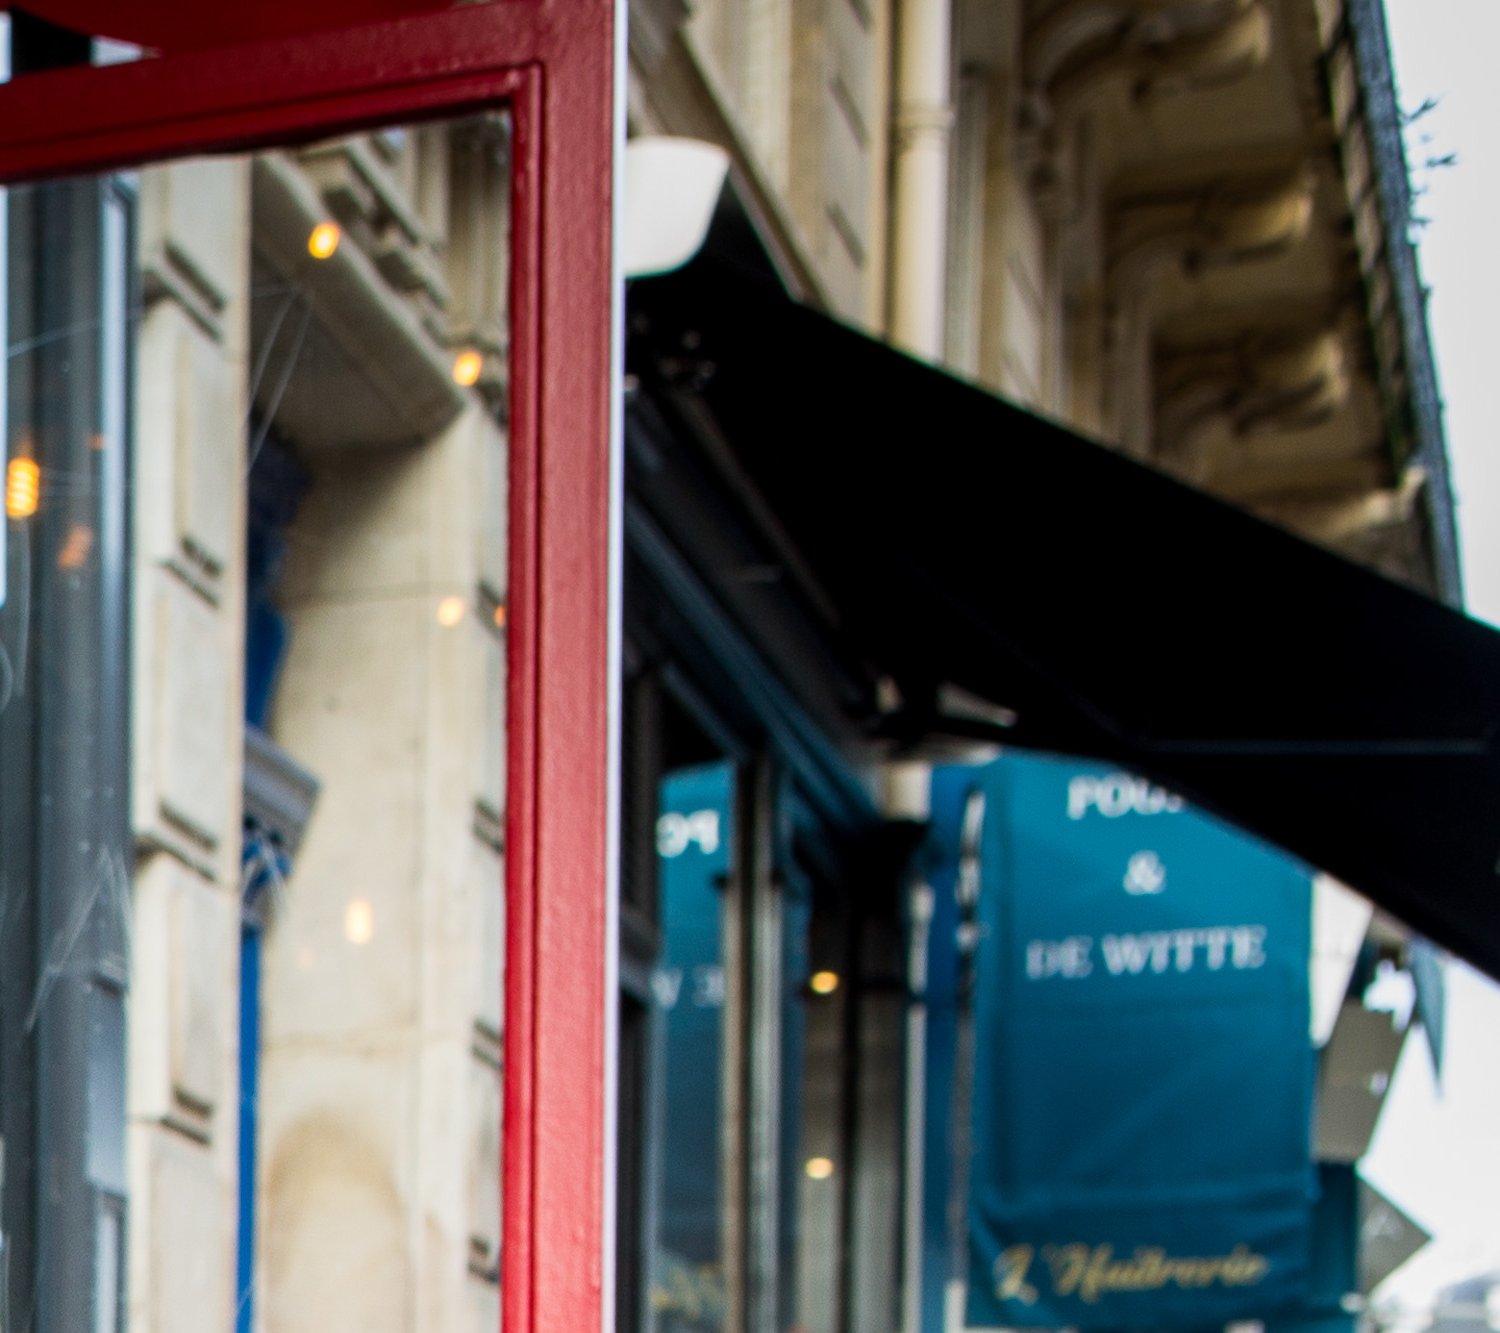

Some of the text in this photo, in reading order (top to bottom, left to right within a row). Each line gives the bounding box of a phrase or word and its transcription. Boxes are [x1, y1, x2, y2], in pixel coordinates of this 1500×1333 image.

[1123, 850, 1167, 895] &
[1025, 924, 1268, 981] DE WITTE
